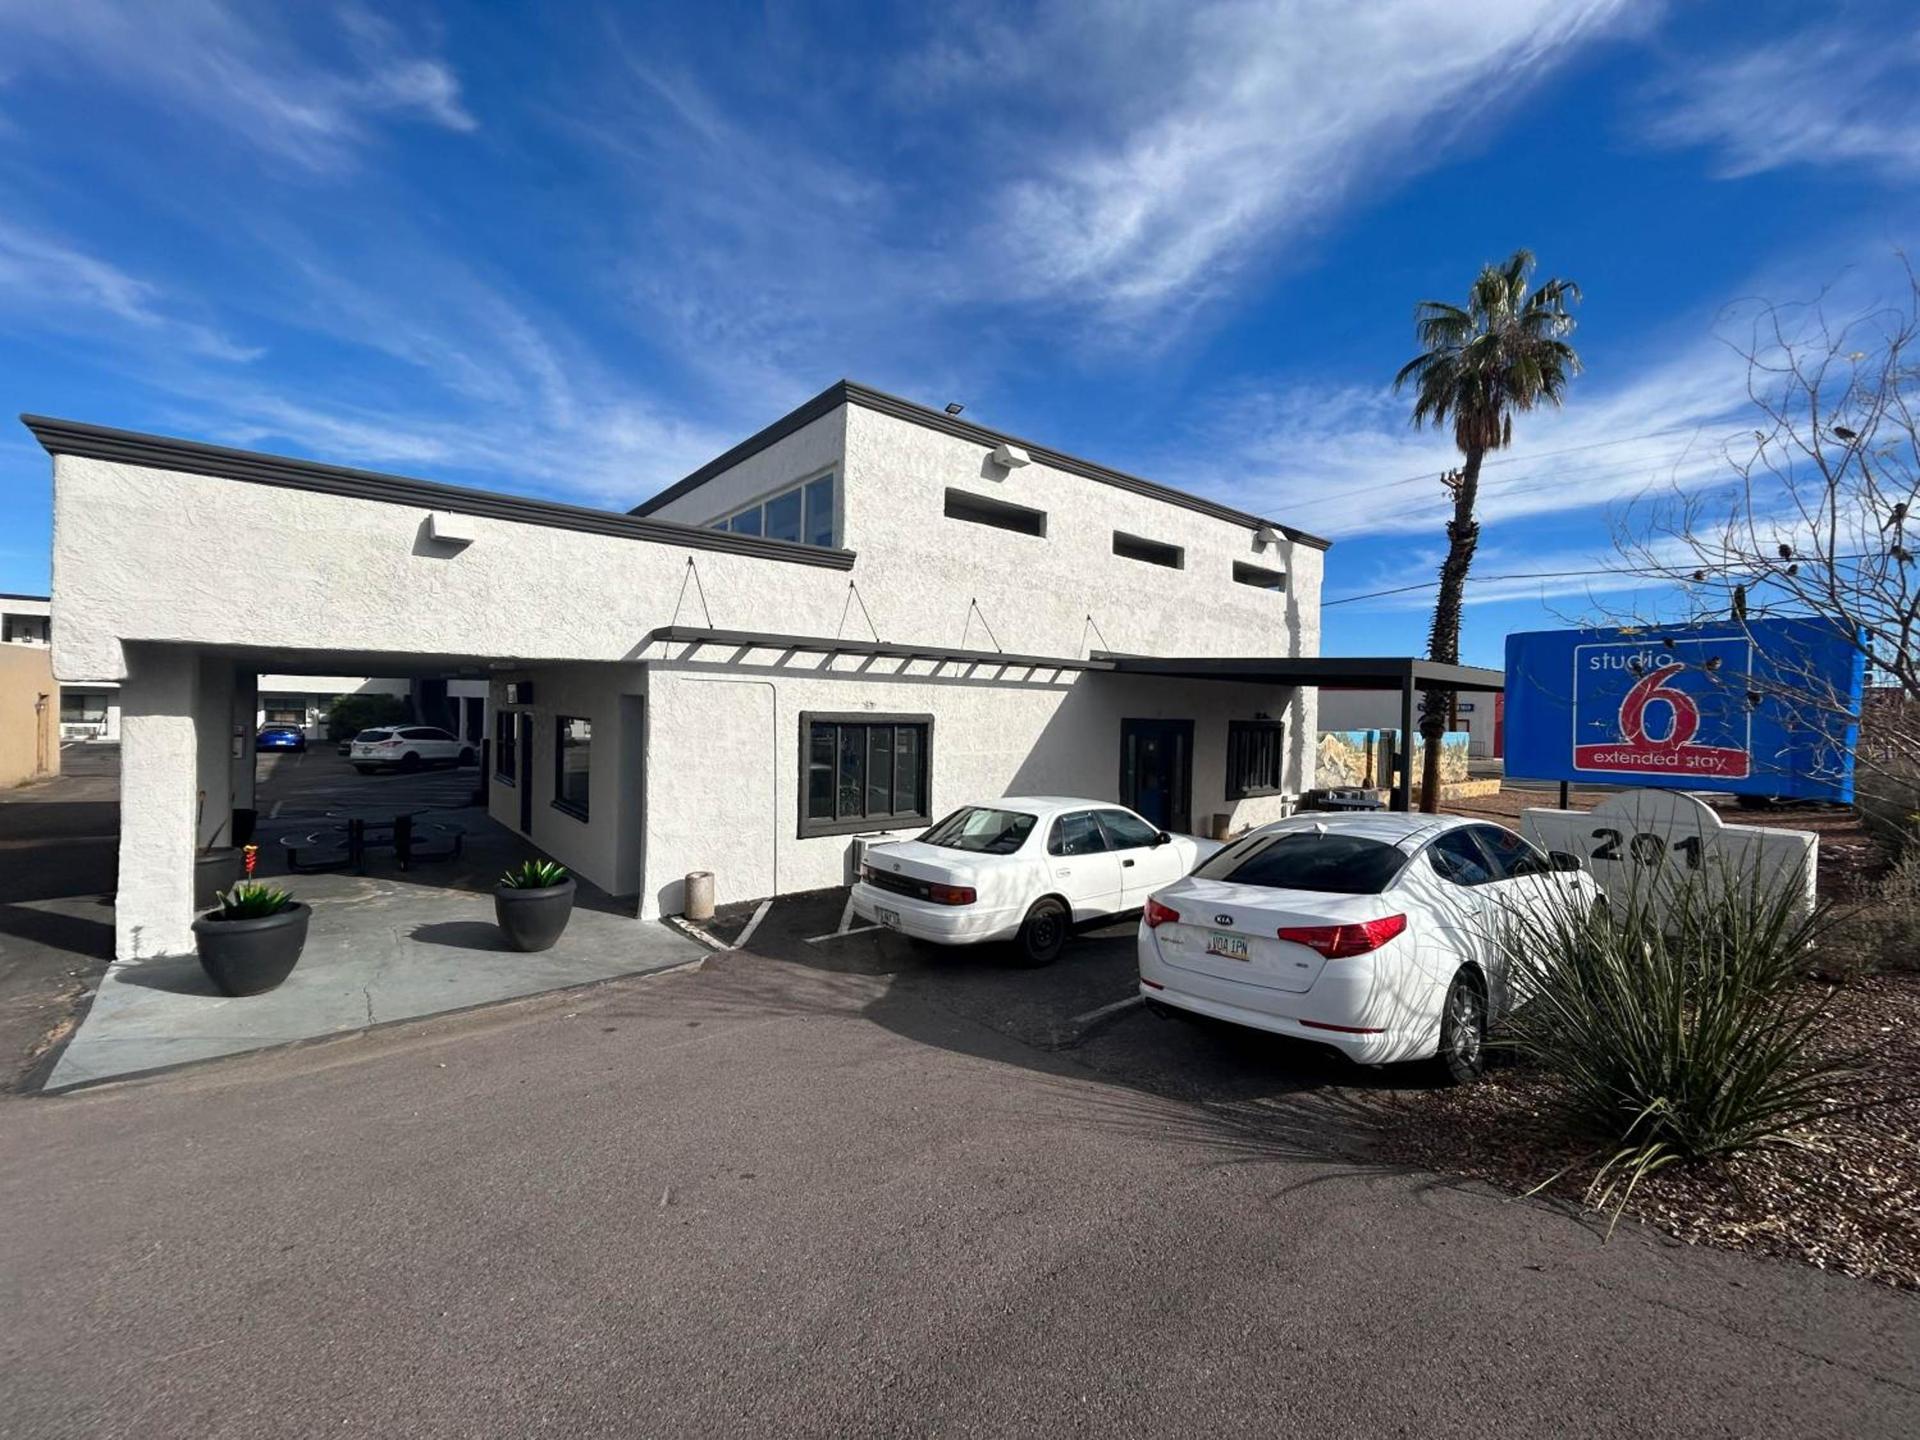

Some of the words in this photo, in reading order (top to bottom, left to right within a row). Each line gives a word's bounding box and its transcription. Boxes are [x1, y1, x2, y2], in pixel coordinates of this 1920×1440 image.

[1590, 651, 1674, 671] studio
[1618, 661, 1701, 746] 6
[1593, 751, 1679, 767] extended
[1685, 754, 1727, 771] stay
[1590, 828, 1701, 870] 201
[1216, 916, 1231, 924] KIA
